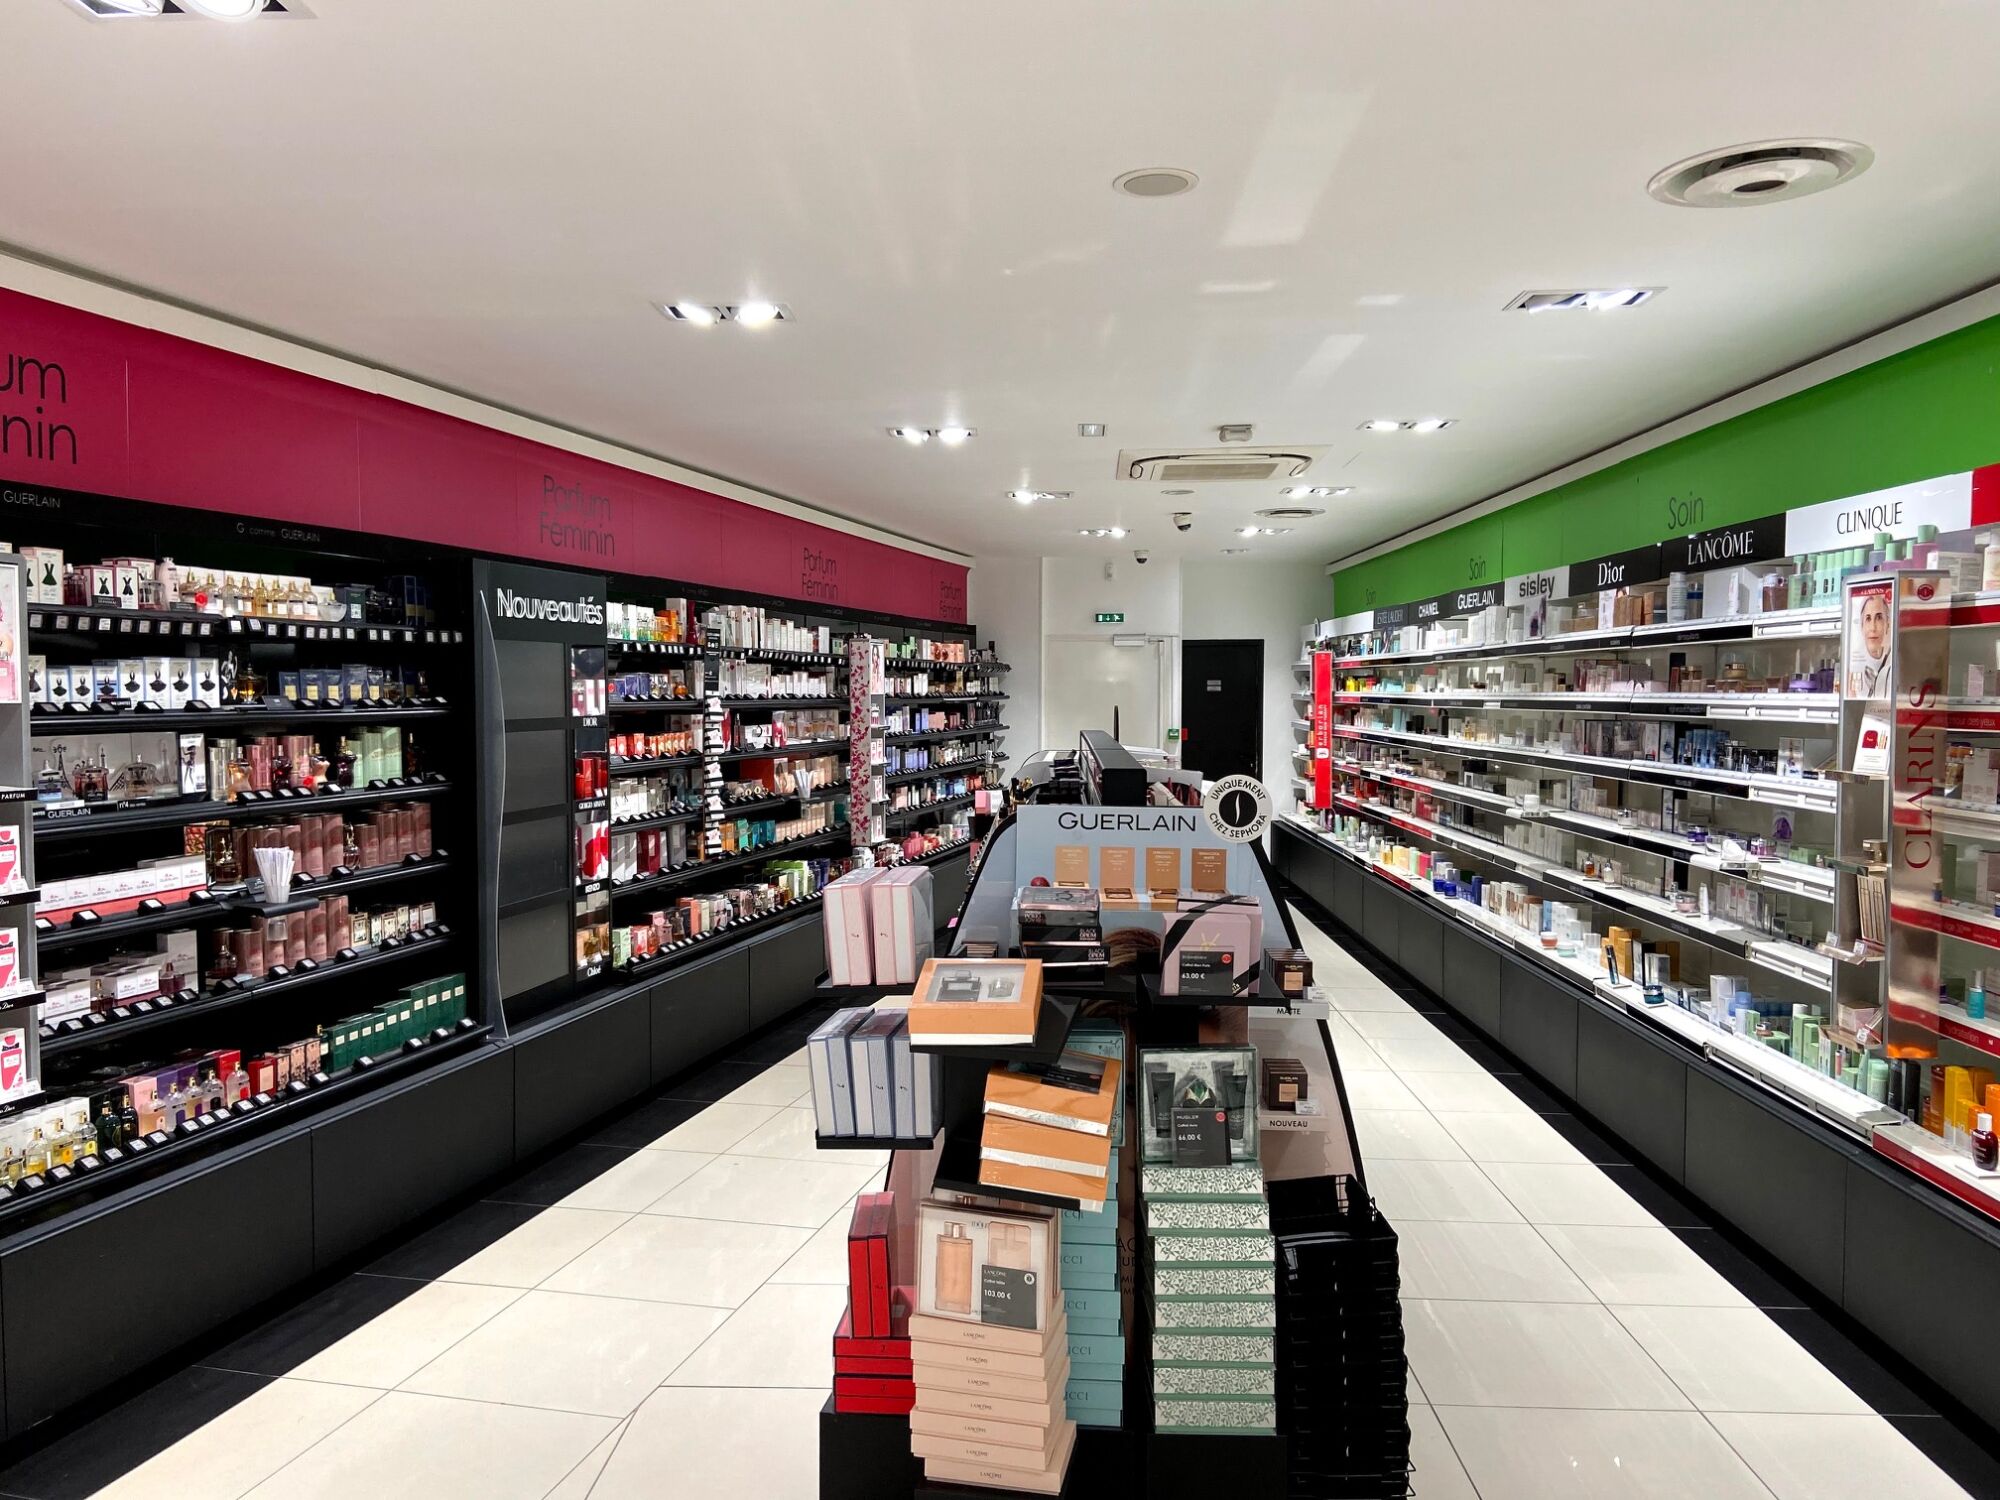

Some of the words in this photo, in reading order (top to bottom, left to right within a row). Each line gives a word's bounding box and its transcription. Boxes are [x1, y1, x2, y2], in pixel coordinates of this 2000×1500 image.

[3, 490, 61, 508] GUERLAIN
[543, 475, 611, 520] Parfum
[1668, 493, 1704, 530] Soin
[1836, 502, 1903, 535] CLINIQUE
[281, 528, 320, 542] GUERLAIN
[1688, 530, 1754, 565] LANCÔME
[803, 547, 837, 576] Parfum
[1469, 556, 1486, 581] Soin
[1597, 561, 1625, 586] Dior
[1519, 573, 1555, 598] sisley
[497, 588, 604, 624] Nouveautés
[1418, 602, 1439, 618] CHANEL
[1458, 590, 1495, 609] GUERLAIN
[1904, 683, 1938, 869] CLARINS
[1, 792, 26, 800] PARFUM
[1211, 779, 1266, 800] UNIQUEMENT
[48, 808, 91, 819] GUERLAIN
[1058, 812, 1196, 832] GUERLAIN
[1209, 813, 1229, 835] CHEZ
[1229, 815, 1267, 838] SEPHORA
